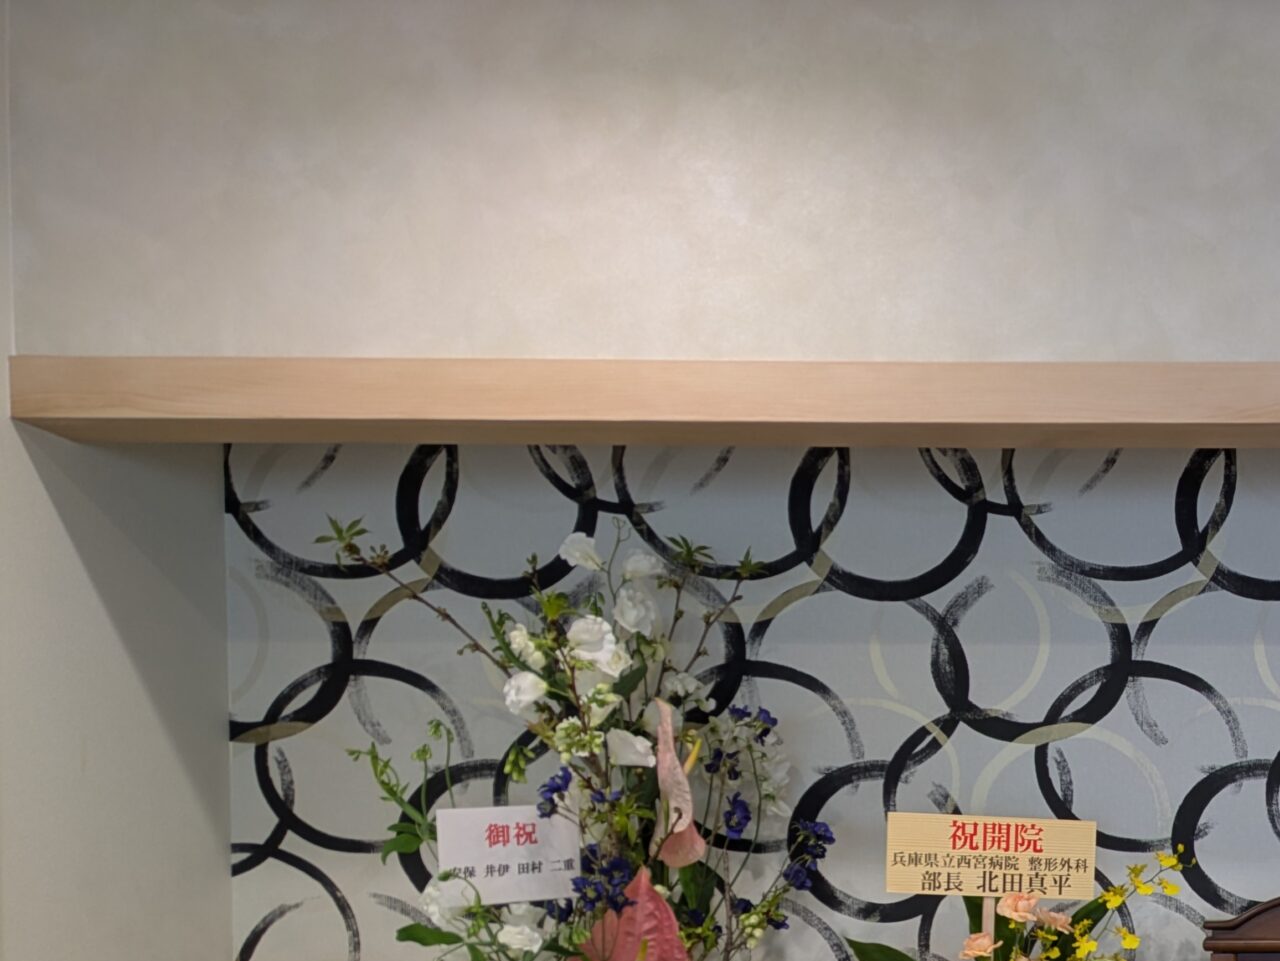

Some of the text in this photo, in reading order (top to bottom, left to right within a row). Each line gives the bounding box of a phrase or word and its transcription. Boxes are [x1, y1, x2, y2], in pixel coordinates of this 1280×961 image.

[485, 822, 538, 848] 御祝
[949, 820, 1044, 853] 祝開院
[484, 863, 510, 878] 井伊
[518, 860, 543, 875] 田村
[550, 858, 576, 872] 二重
[891, 851, 1089, 873] 兵庫県立西宮病院 整形外科
[921, 870, 1072, 895] 部長 北田真平
